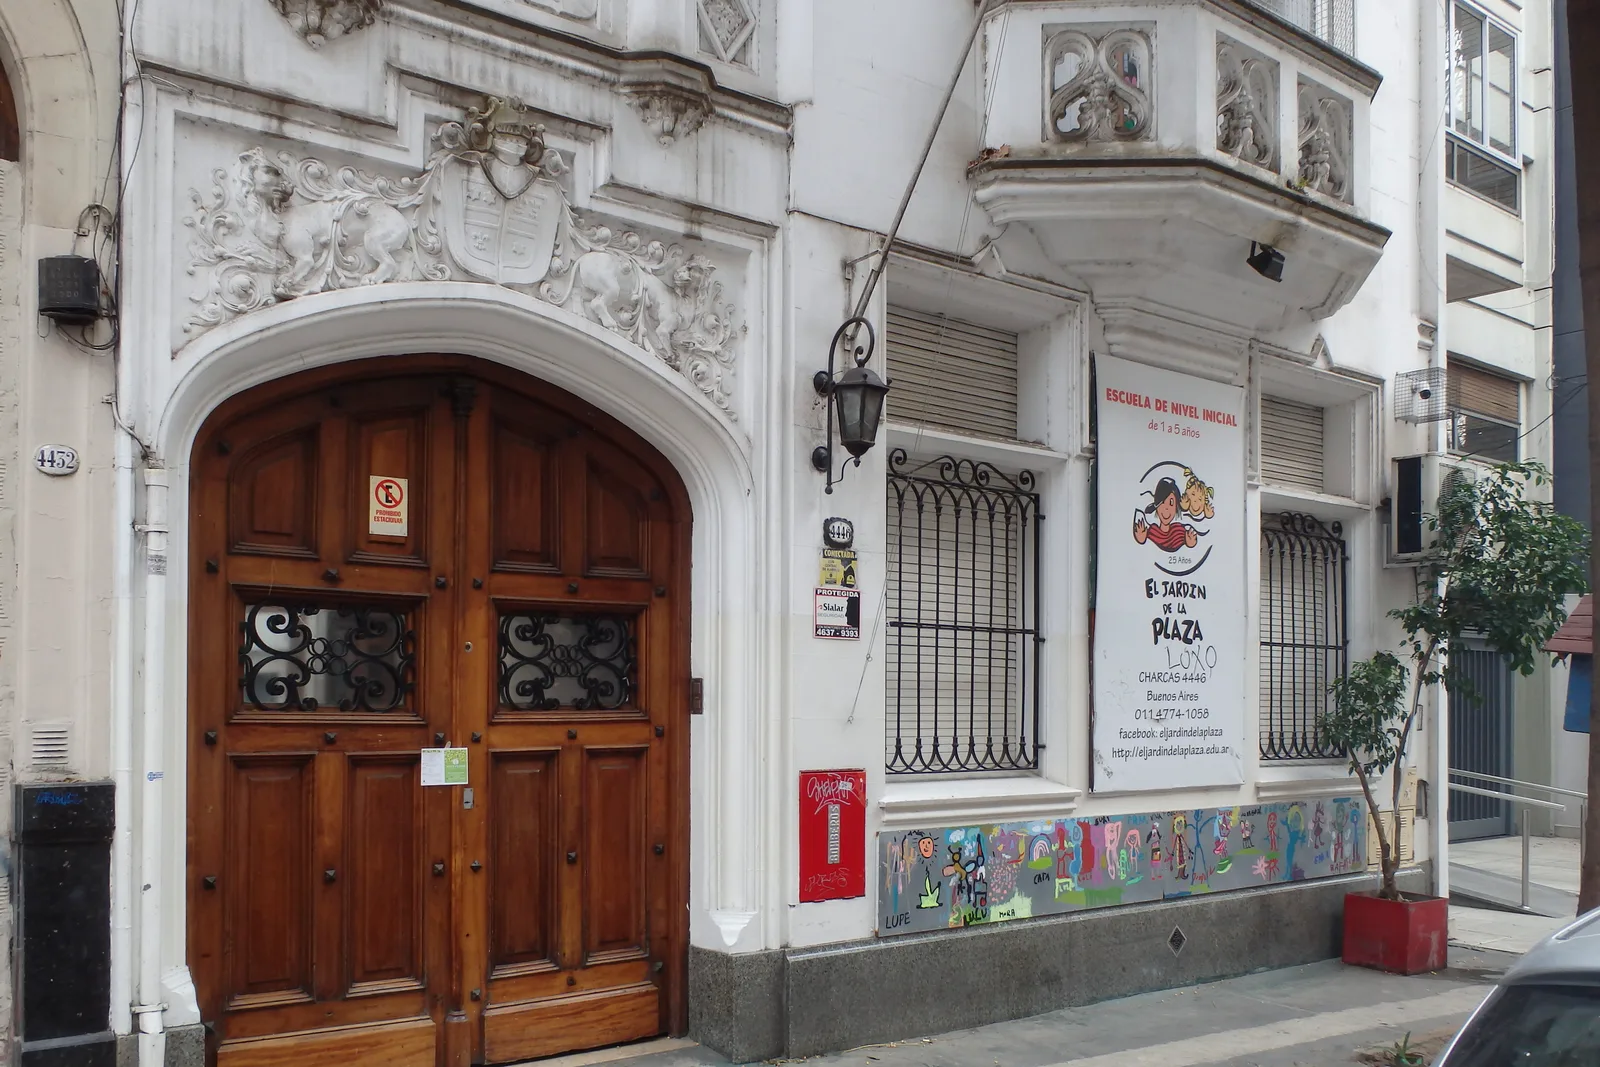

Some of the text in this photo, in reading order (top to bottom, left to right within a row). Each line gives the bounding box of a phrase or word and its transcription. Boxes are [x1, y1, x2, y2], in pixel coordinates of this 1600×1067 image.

[1106, 388, 1237, 427] ESCUELA DE NIVEL INICIAL
[1148, 419, 1200, 438] de 1 a 5 años
[830, 525, 850, 540] 4446
[1168, 556, 1177, 564] 25
[1145, 578, 1206, 600] EL JARDIN
[823, 603, 844, 611] Sialar
[1163, 602, 1187, 615] DE LA
[1152, 617, 1203, 645] PLAZA
[1139, 672, 1206, 683] CHARCAS 4446
[1147, 690, 1199, 701] Buenos Aires
[1135, 708, 1209, 720] 011 4774-1058
[1119, 726, 1223, 741] facebook: eljardindelaplaza
[1112, 744, 1229, 762] http://eljardindelaplaza.edu.ar
[829, 804, 840, 863] BOMBEROS
[886, 912, 910, 929] LUPE
